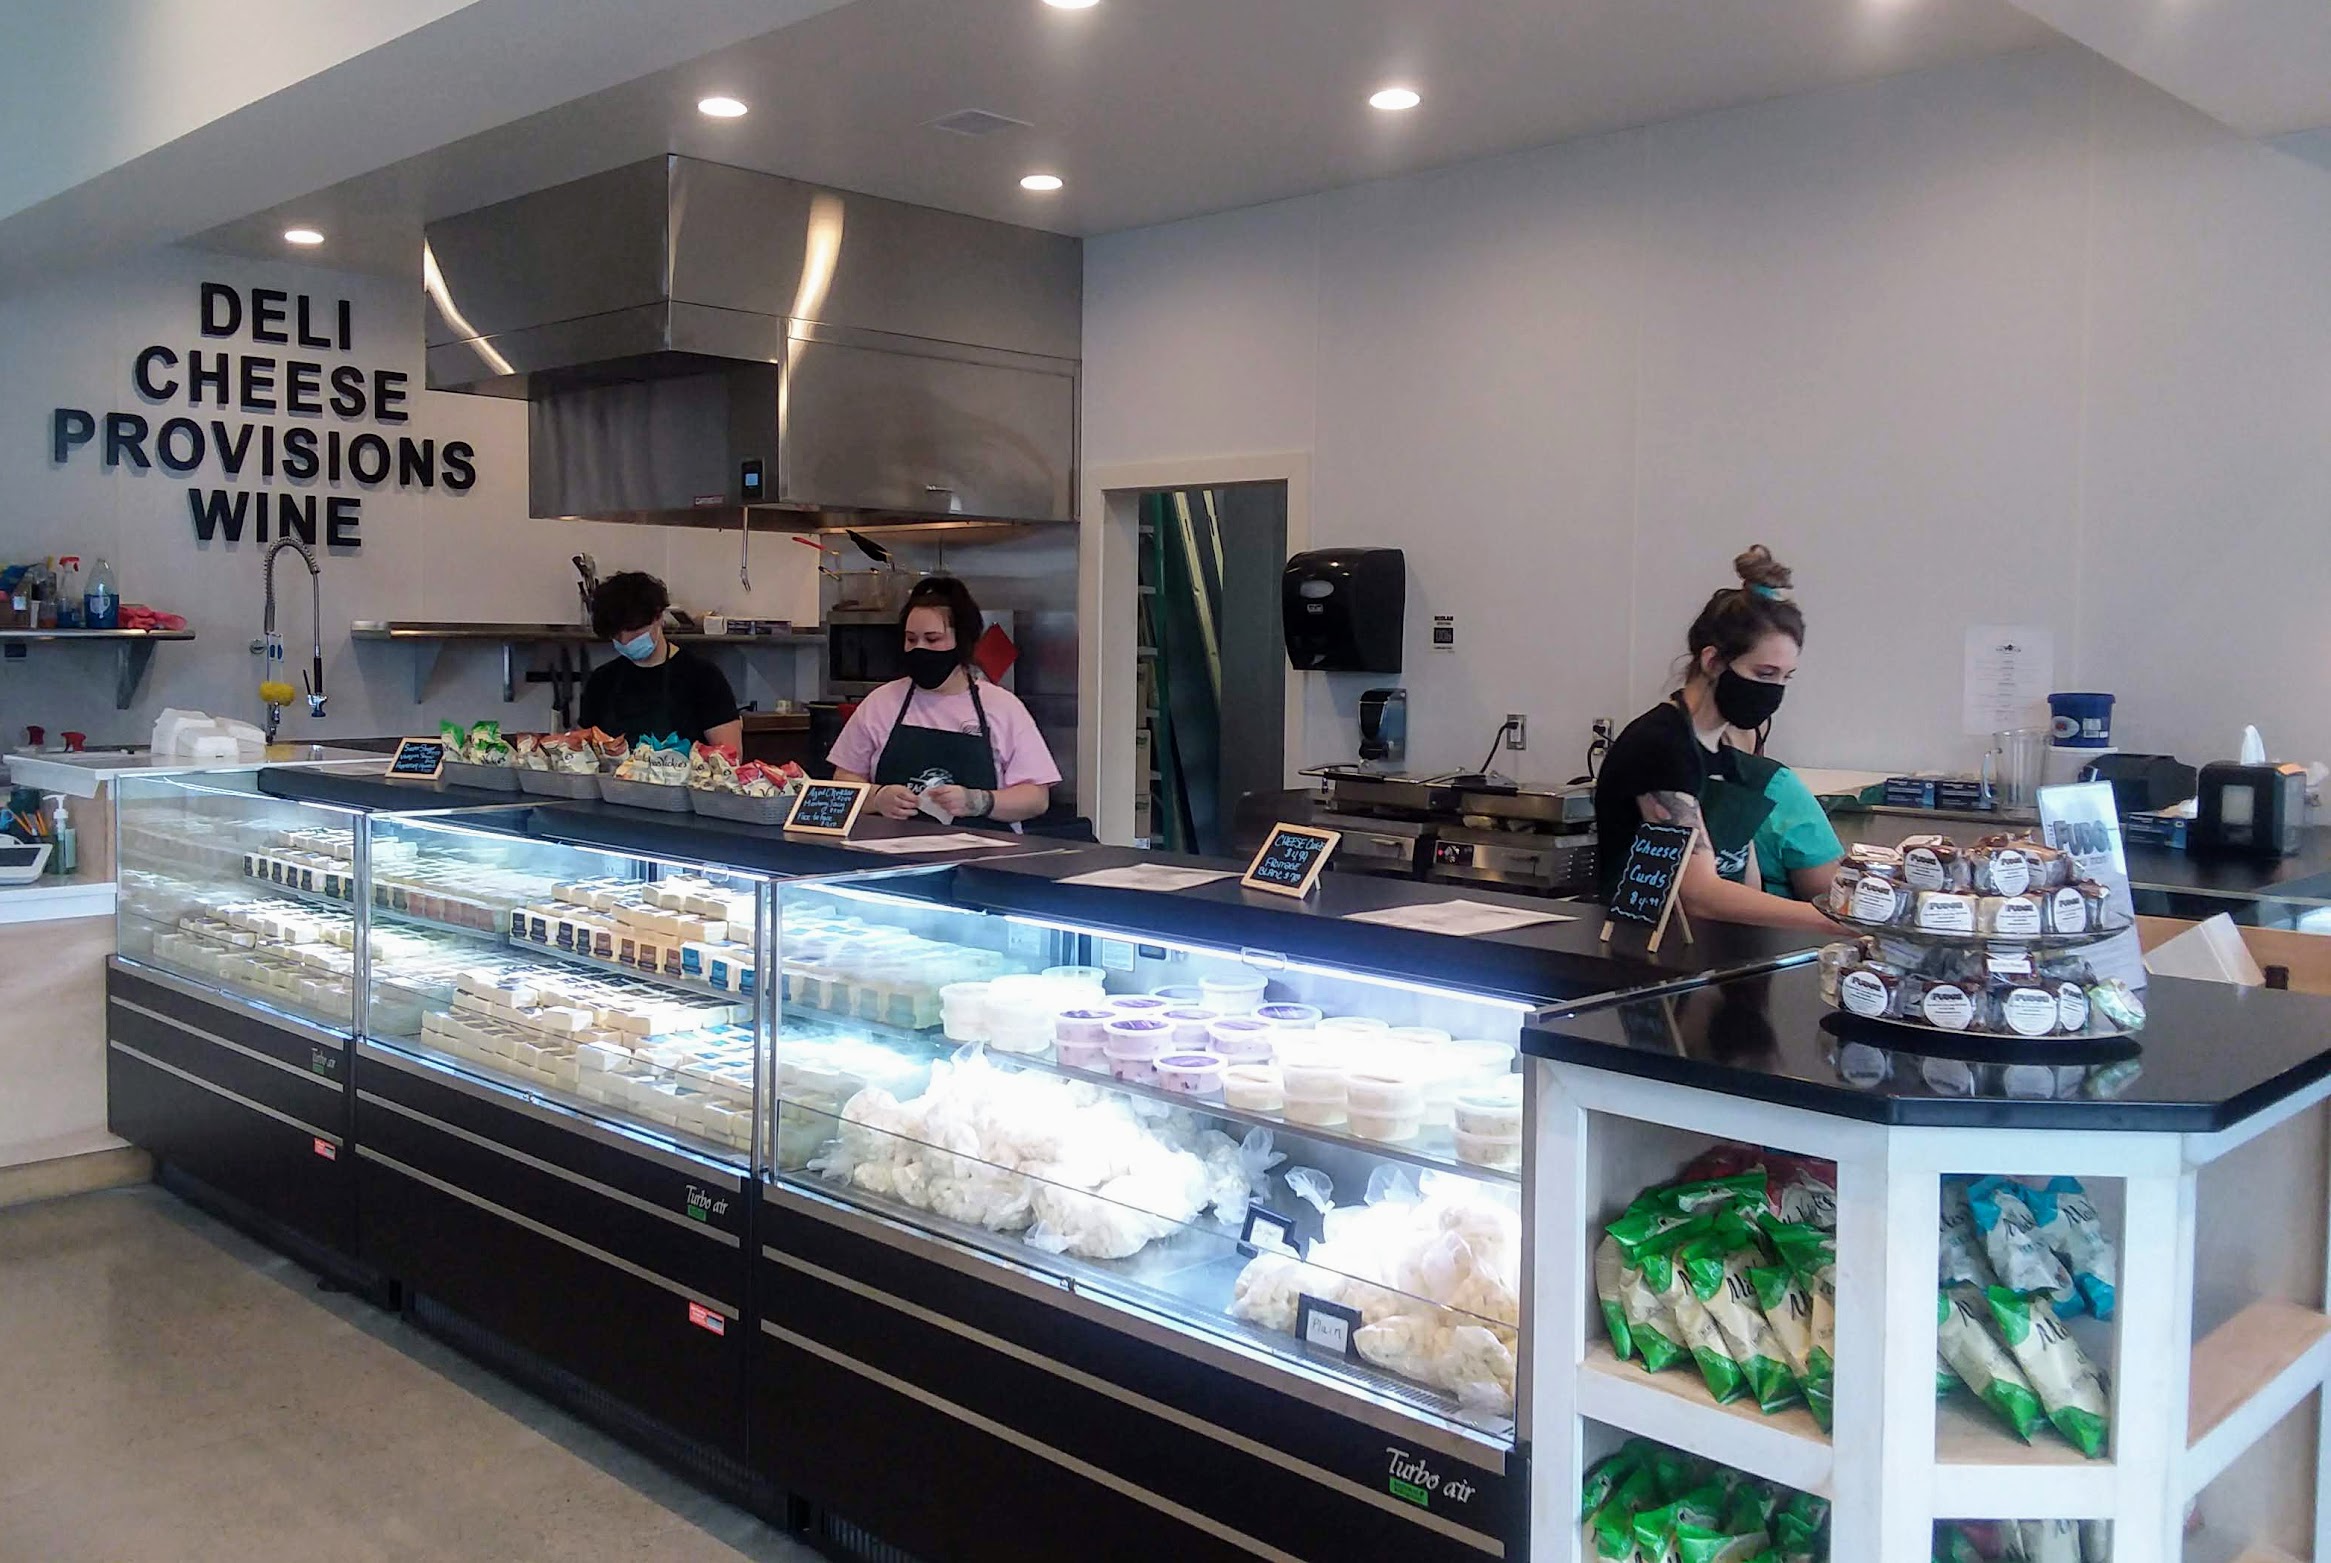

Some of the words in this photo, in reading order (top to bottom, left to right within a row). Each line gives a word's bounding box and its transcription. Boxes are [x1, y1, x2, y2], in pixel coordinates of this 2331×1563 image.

[201, 282, 351, 351] DELI
[135, 345, 409, 421] CHEESE
[54, 407, 477, 490] PROVISIONS
[188, 488, 362, 546] WINE
[1274, 834, 1308, 849] CHEESE
[1635, 838, 1679, 861] Cheese
[1629, 864, 1667, 888] Curds
[685, 1184, 712, 1210] Turbo
[712, 1198, 729, 1216] air
[1312, 1317, 1342, 1340] Plain
[1385, 1447, 1441, 1491] Turbo
[1443, 1478, 1476, 1504] air
